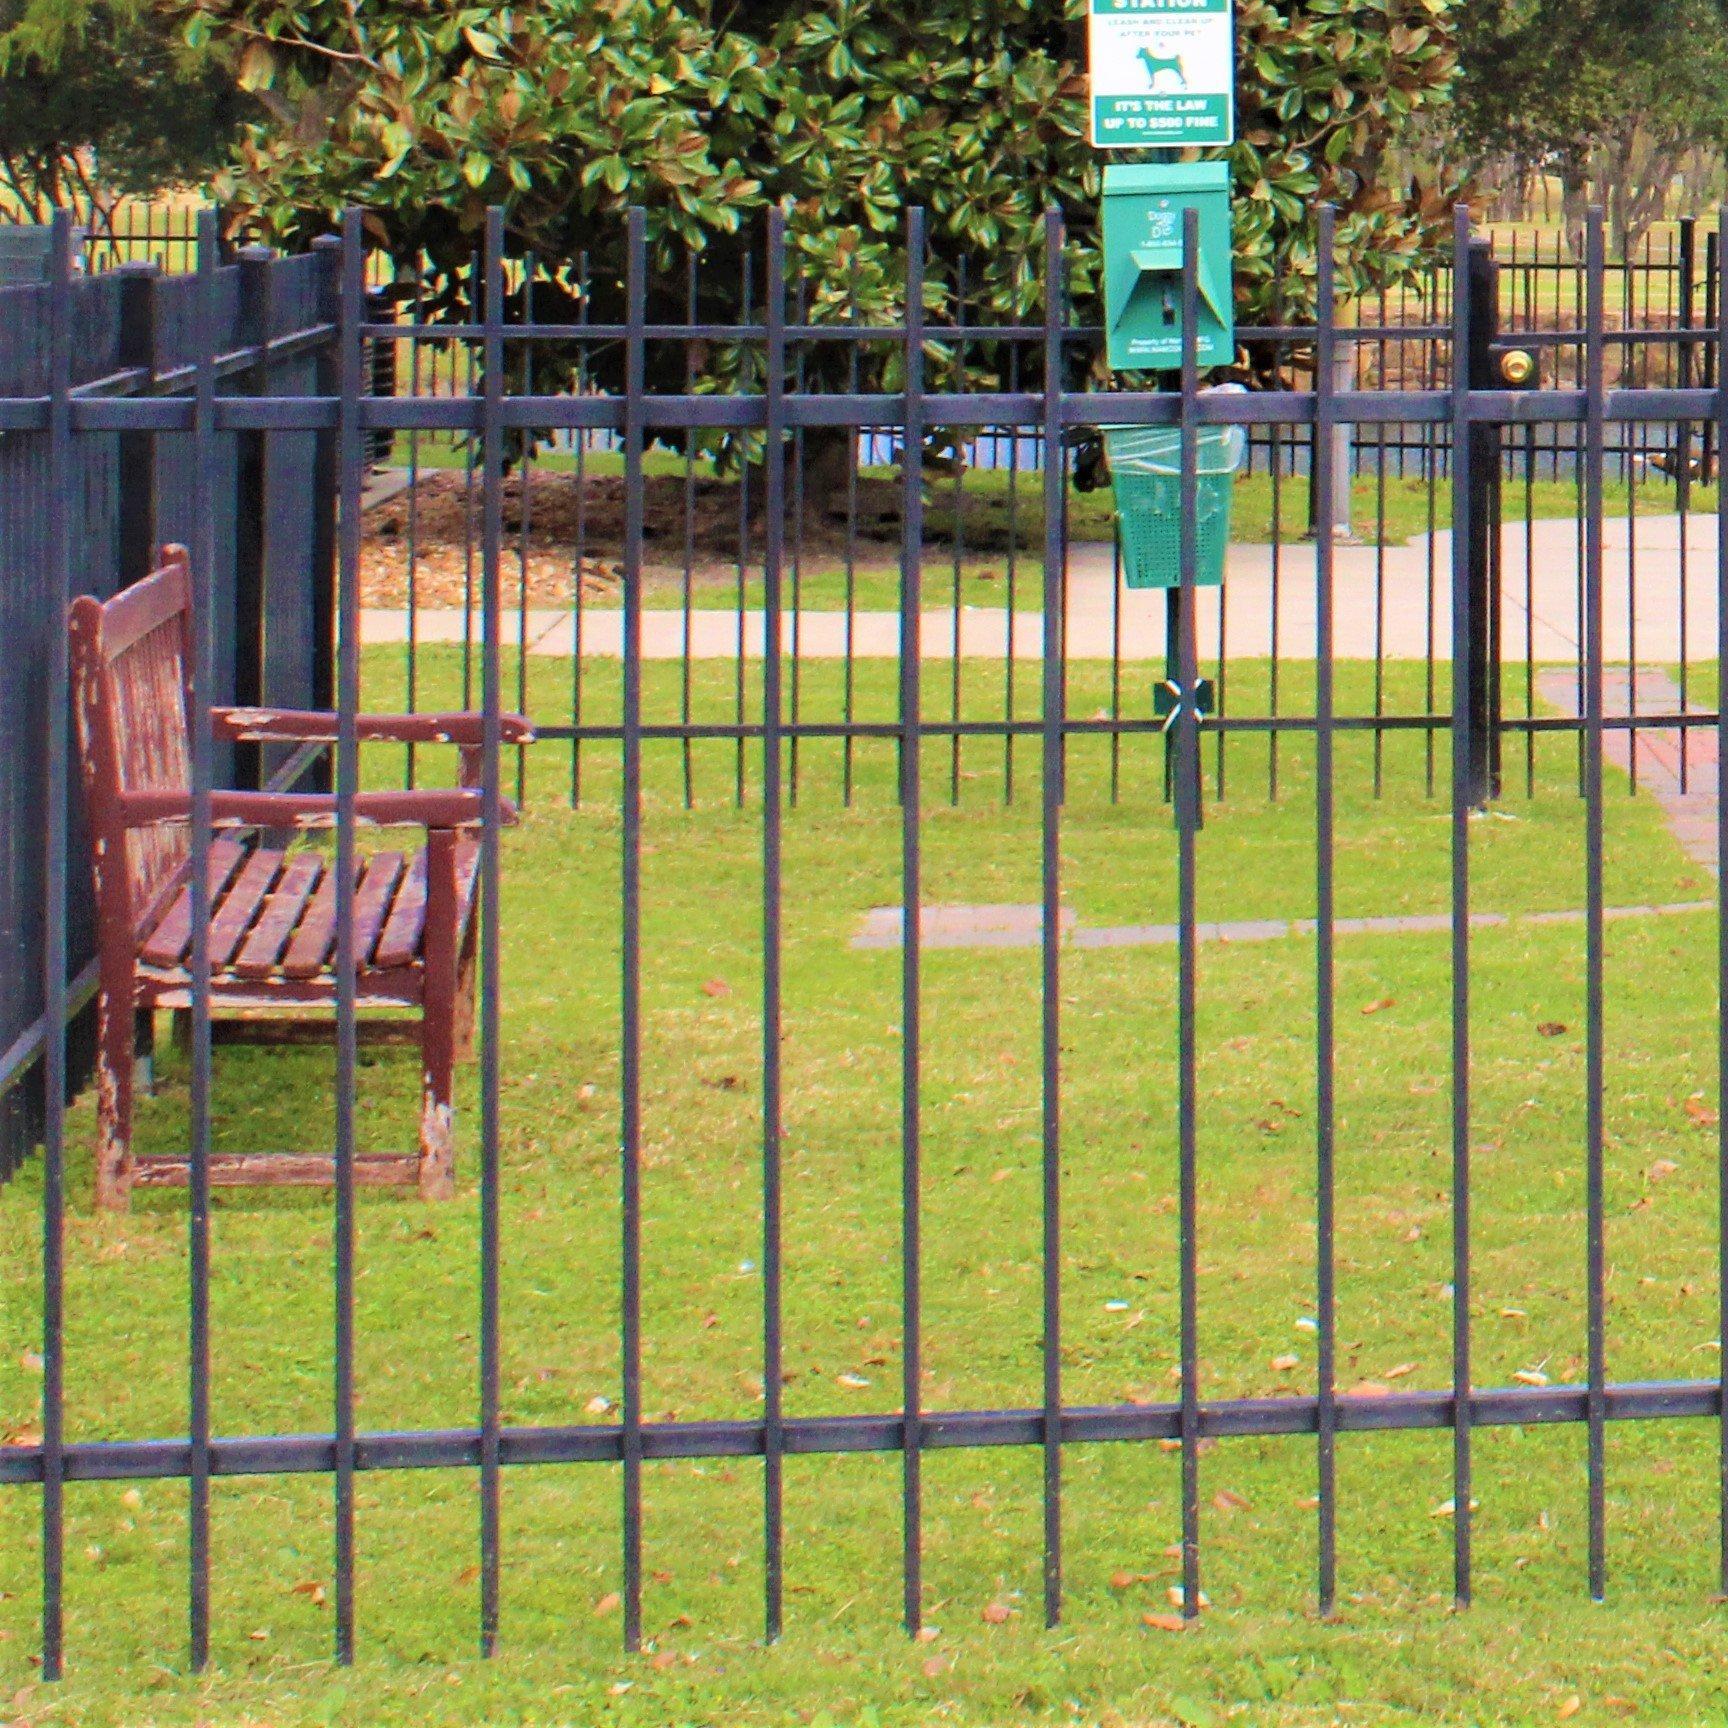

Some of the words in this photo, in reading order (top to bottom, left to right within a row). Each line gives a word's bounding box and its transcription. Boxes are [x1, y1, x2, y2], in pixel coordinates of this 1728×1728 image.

[1115, 100, 1143, 112] IT'S
[1145, 100, 1174, 111] THE
[1176, 99, 1208, 111] LAW
[1103, 117, 1125, 129] UP
[1127, 117, 1147, 129] TO
[1149, 116, 1183, 129] $500
[1185, 116, 1219, 128] FINE
